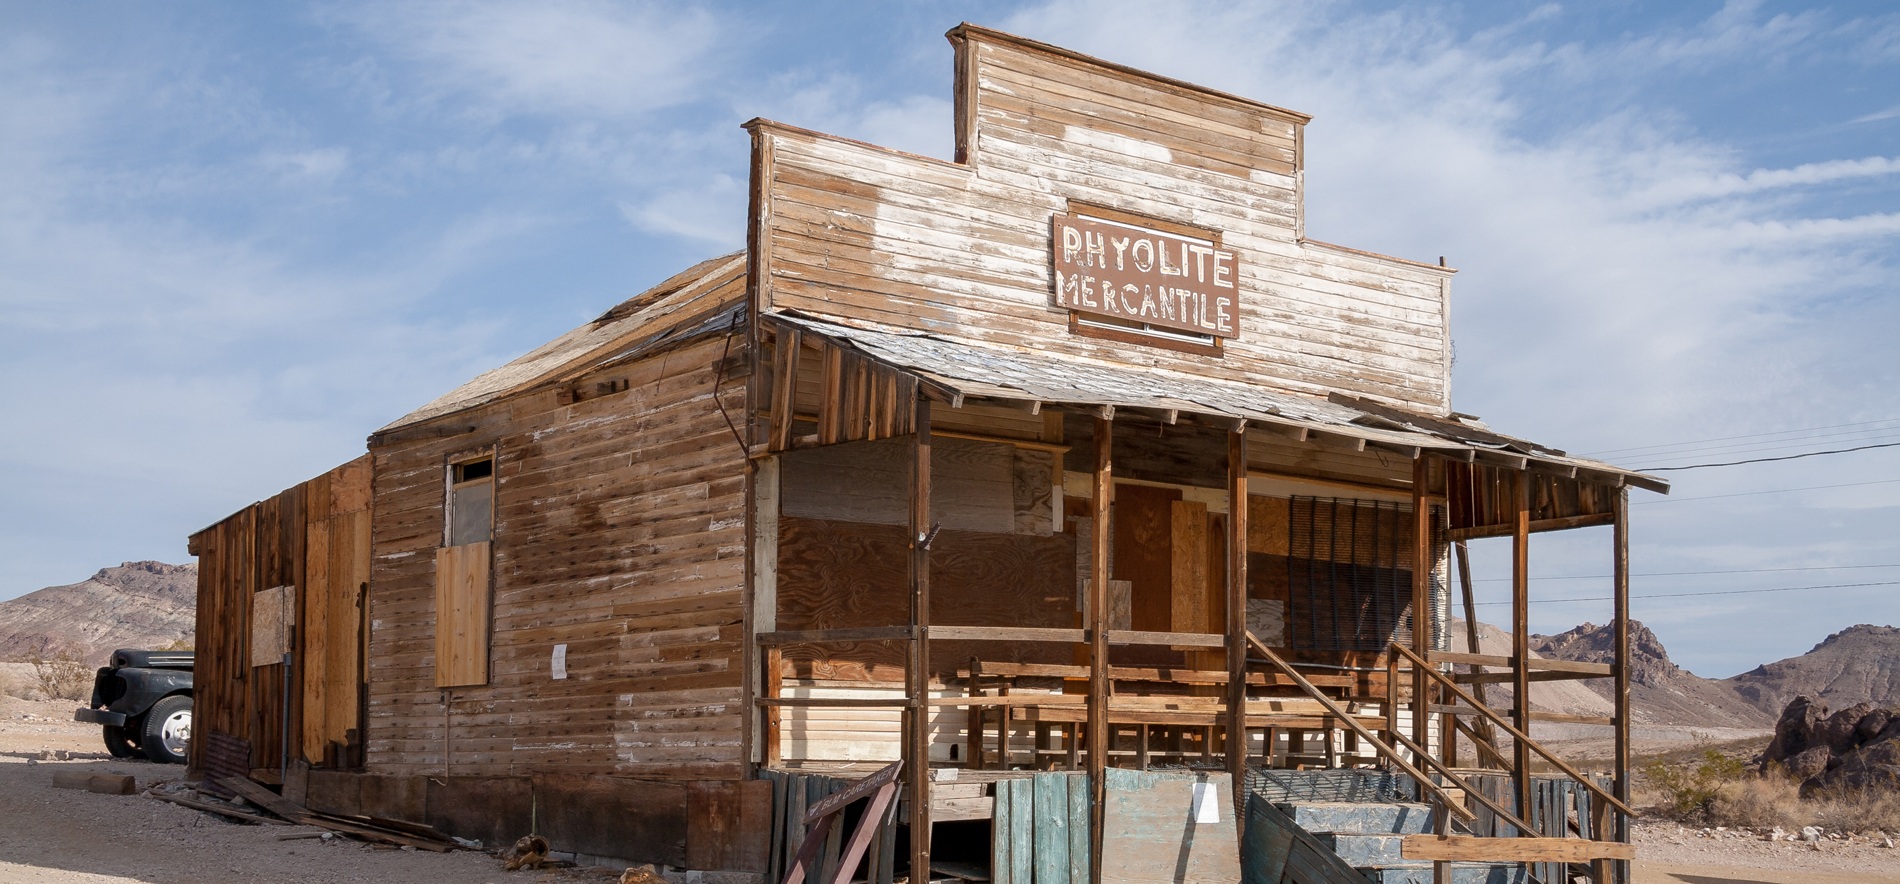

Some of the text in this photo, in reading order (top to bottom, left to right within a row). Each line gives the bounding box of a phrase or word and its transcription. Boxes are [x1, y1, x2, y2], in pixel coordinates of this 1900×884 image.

[1063, 225, 1234, 288] RHYOLITE
[1056, 270, 1233, 333] MERCANTILE
[842, 767, 895, 800] CARETAKER
